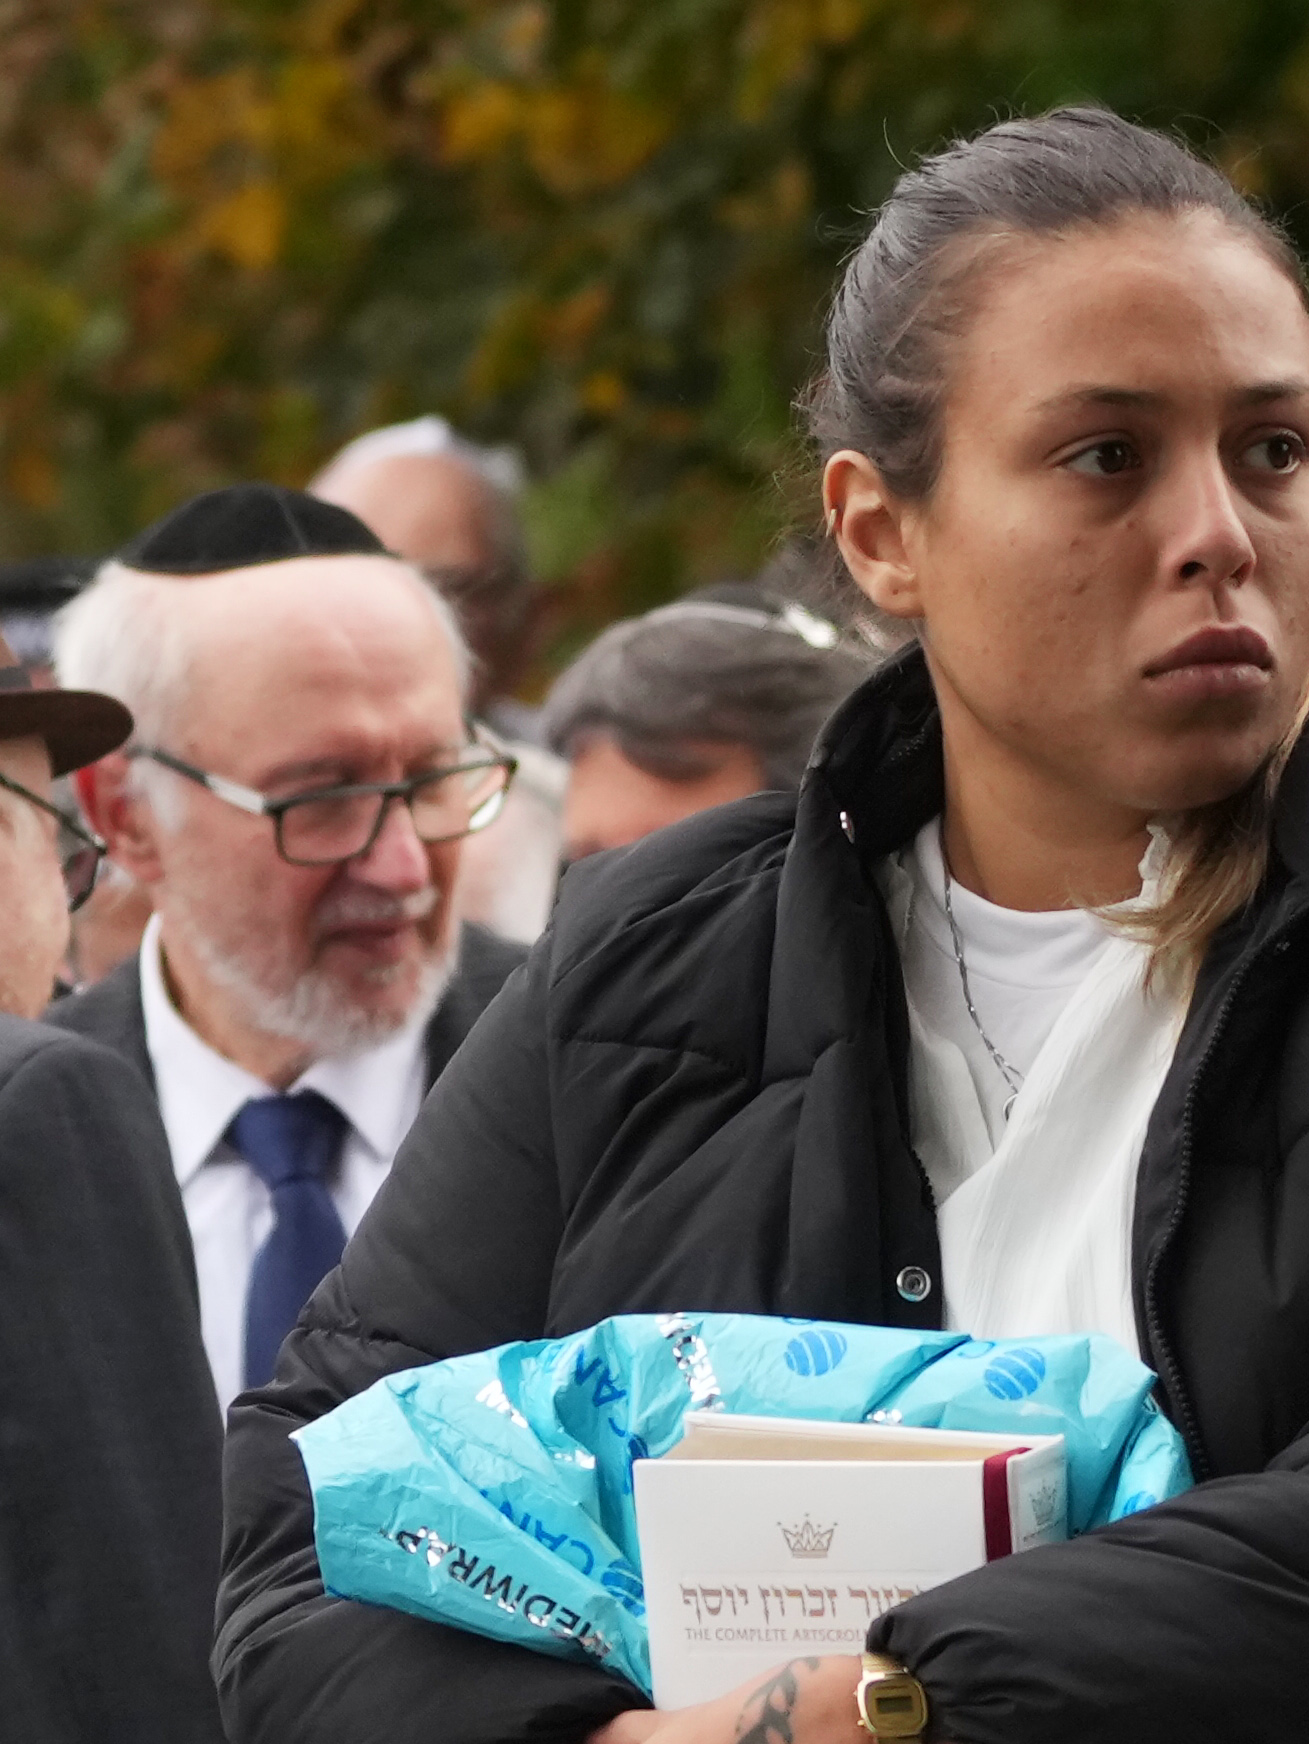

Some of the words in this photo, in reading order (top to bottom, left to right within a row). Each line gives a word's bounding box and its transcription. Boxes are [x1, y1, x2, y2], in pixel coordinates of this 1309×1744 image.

[680, 1583, 749, 1625] יוסף
[686, 1628, 711, 1641] THE
[715, 1628, 787, 1641] COMPLETE
